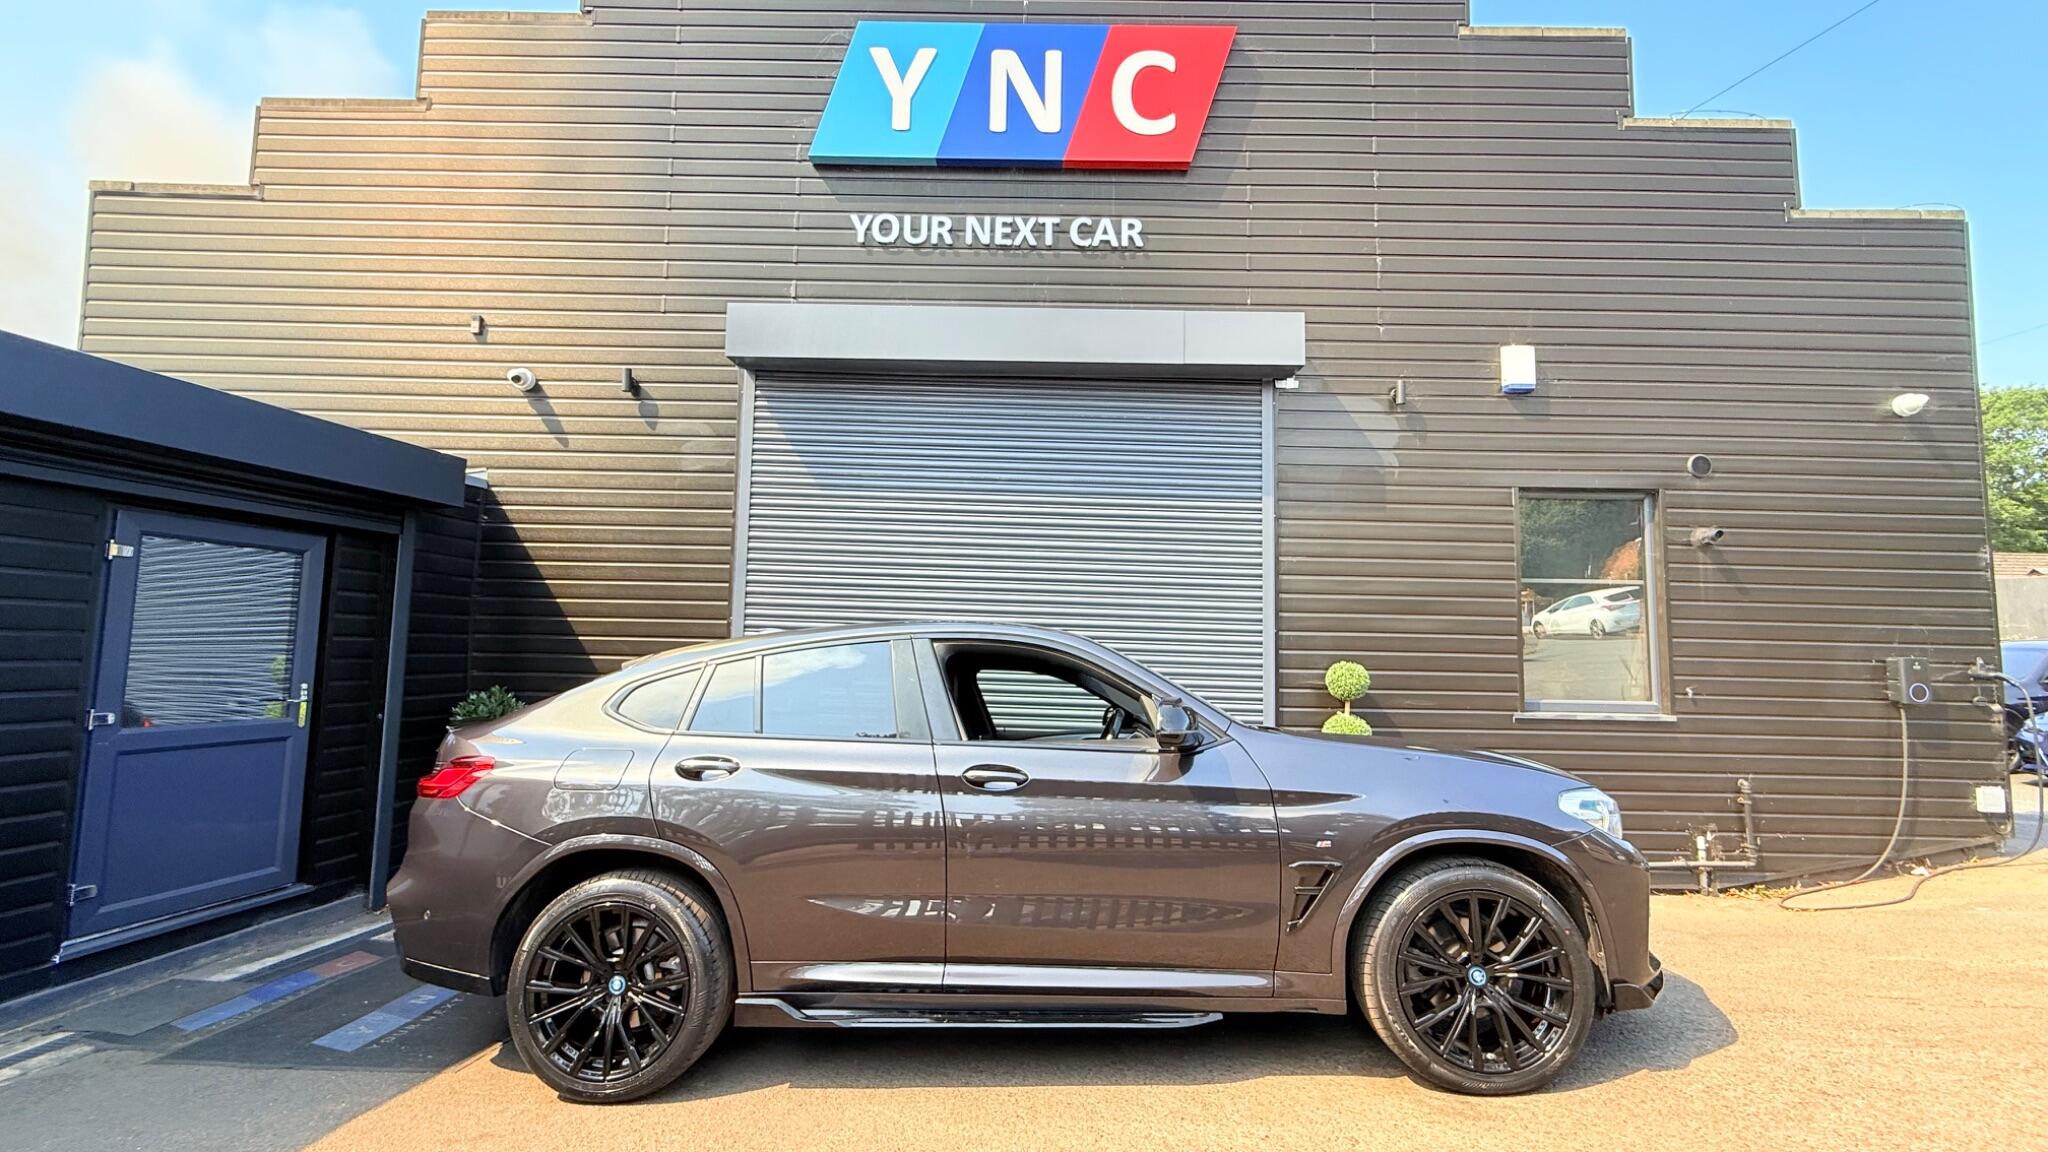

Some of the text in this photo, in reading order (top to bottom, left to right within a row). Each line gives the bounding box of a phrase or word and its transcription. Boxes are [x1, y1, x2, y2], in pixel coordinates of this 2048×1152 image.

[869, 47, 1177, 136] YNC
[850, 213, 1144, 249] YOUR NEXT CAR
